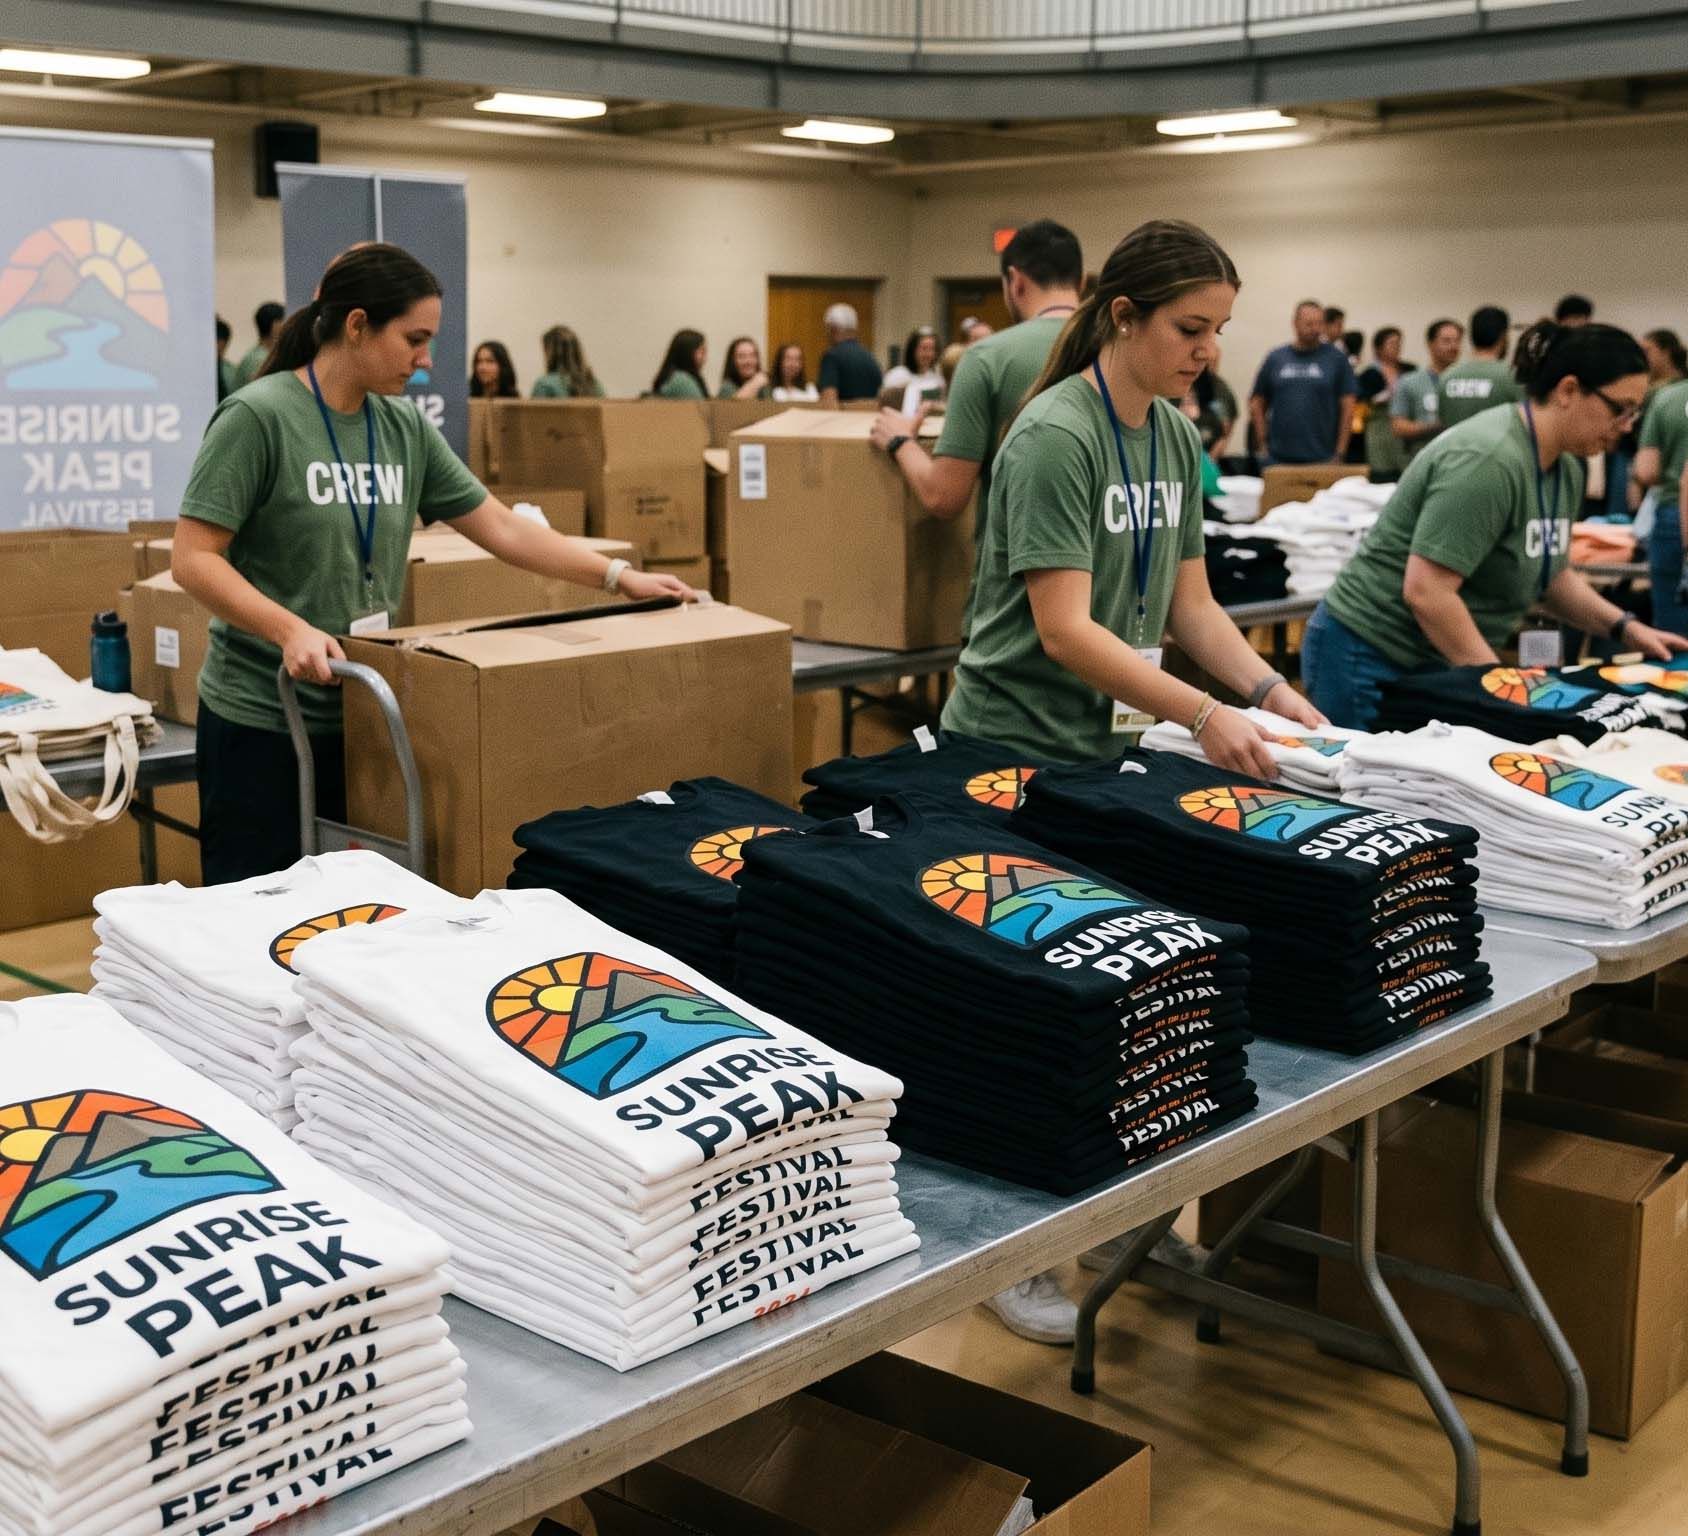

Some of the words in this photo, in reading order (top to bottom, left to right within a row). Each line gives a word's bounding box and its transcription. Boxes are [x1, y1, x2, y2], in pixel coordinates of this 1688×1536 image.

[1445, 378, 1494, 399] CREW
[306, 460, 404, 505] CREW
[1104, 481, 1184, 534] CREW
[1345, 822, 1449, 866] PEAK
[1044, 910, 1196, 970] SUNRISE
[1092, 922, 1223, 982] PEAK
[616, 1047, 834, 1131] SUNRISE
[676, 1071, 865, 1161] PEAK
[690, 1146, 853, 1213] FESTIVAL
[690, 1172, 852, 1253] FESTIVAL
[54, 1200, 350, 1326] SUNRISE
[125, 1235, 383, 1358] PEAK
[693, 1217, 857, 1304] FESTIVAL
[147, 1343, 384, 1463] FESTIVAL
[156, 1316, 380, 1428] FESTIVAL
